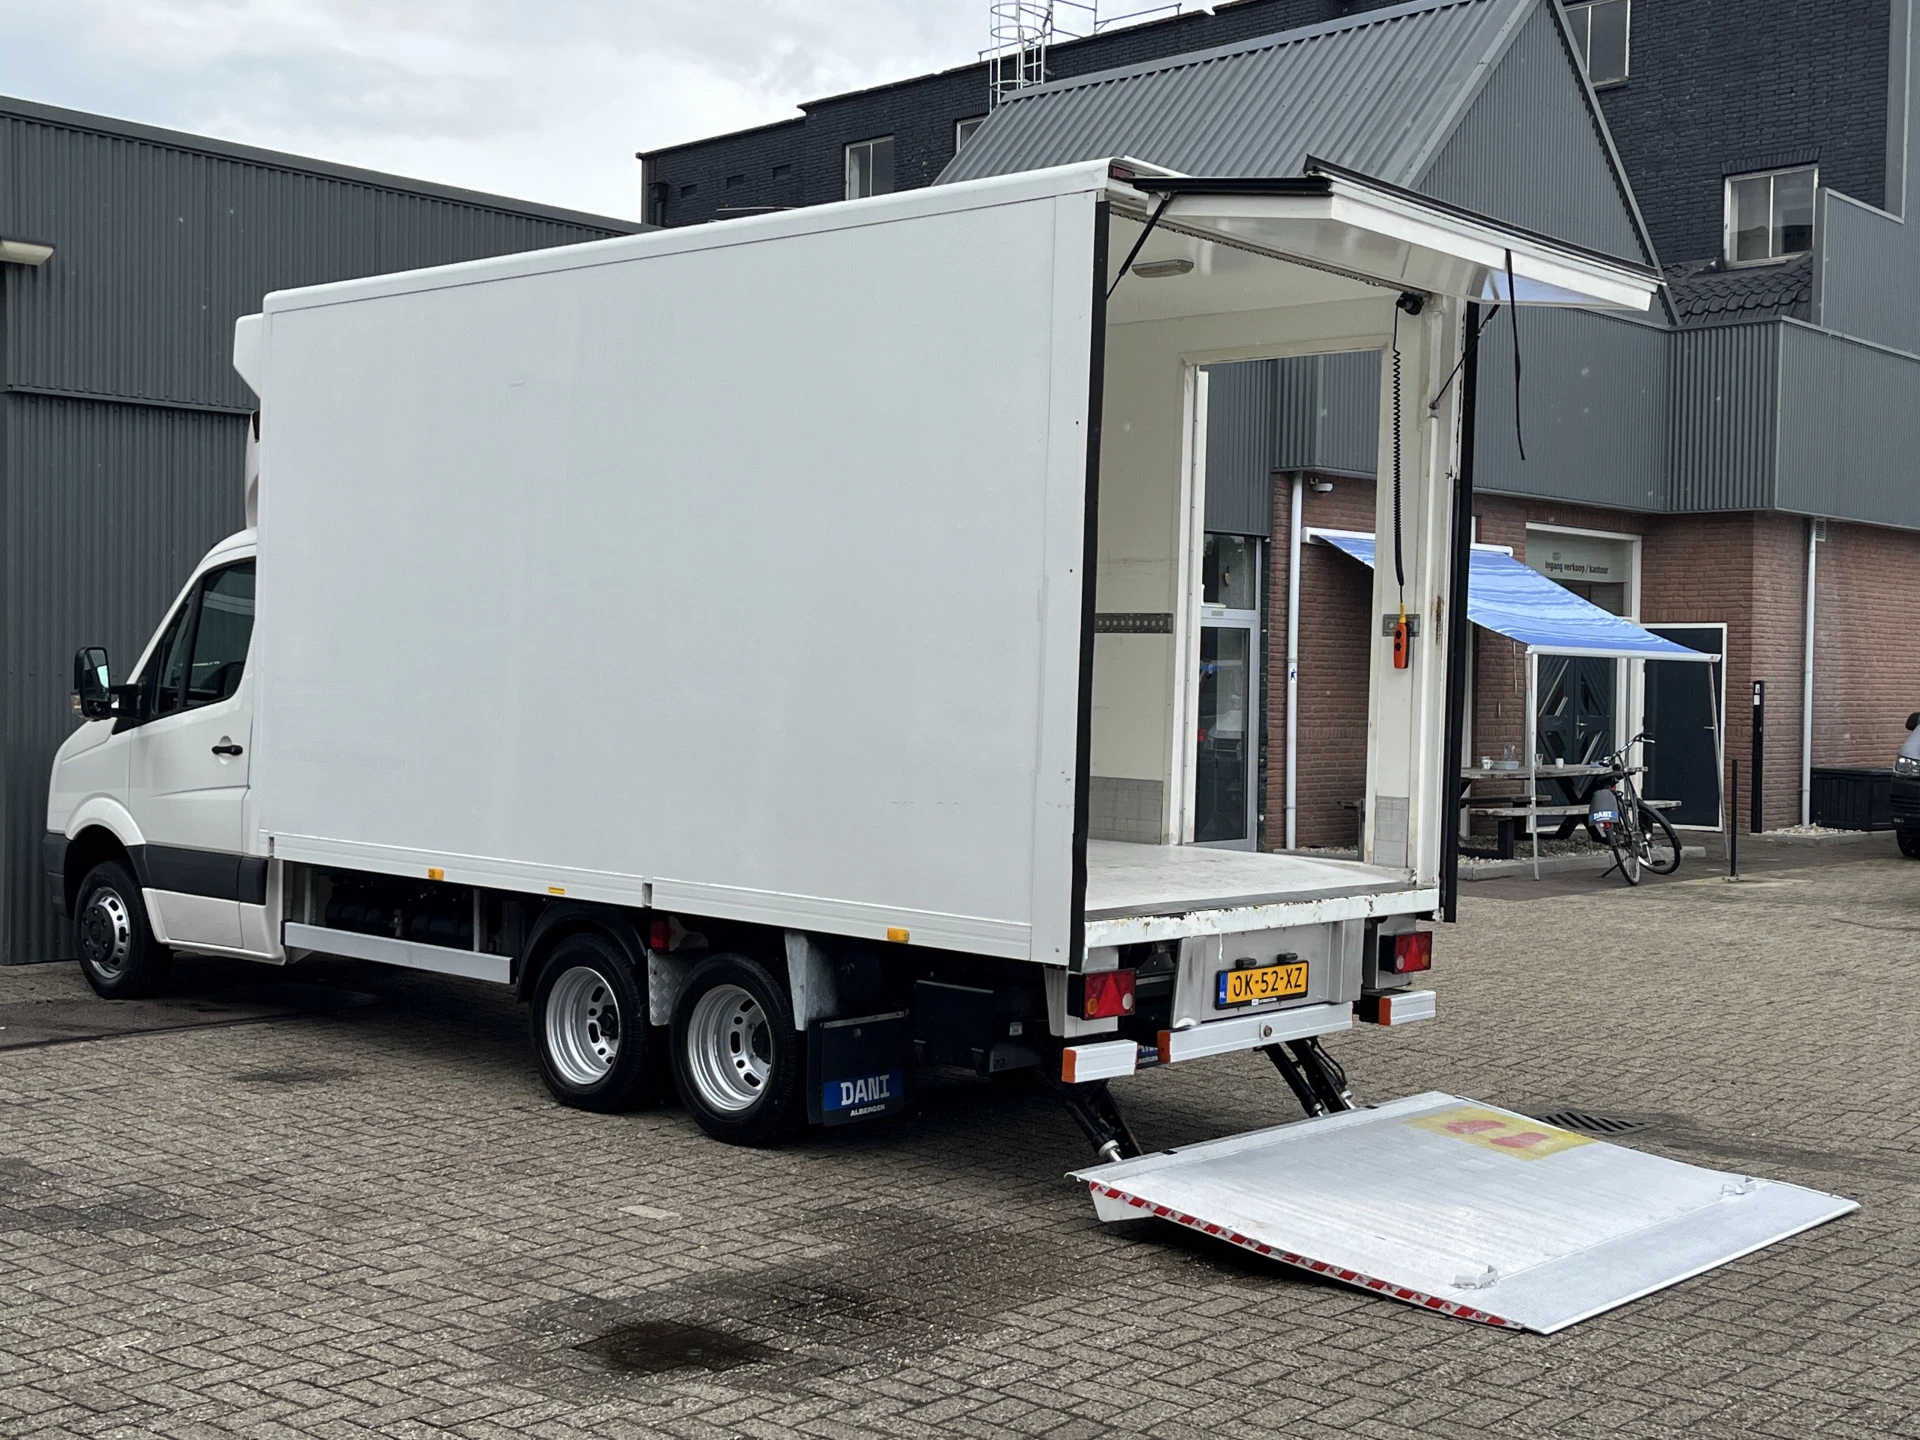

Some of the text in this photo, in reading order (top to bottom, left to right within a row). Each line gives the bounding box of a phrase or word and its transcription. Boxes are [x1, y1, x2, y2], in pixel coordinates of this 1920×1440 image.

[1564, 563, 1585, 574] verkoop
[1589, 564, 1609, 574] kantoor
[1233, 967, 1303, 997] OK-52-XZ
[1219, 991, 1226, 999] NL
[840, 1074, 890, 1106] DANI
[850, 1104, 886, 1117] ALBERGEN
